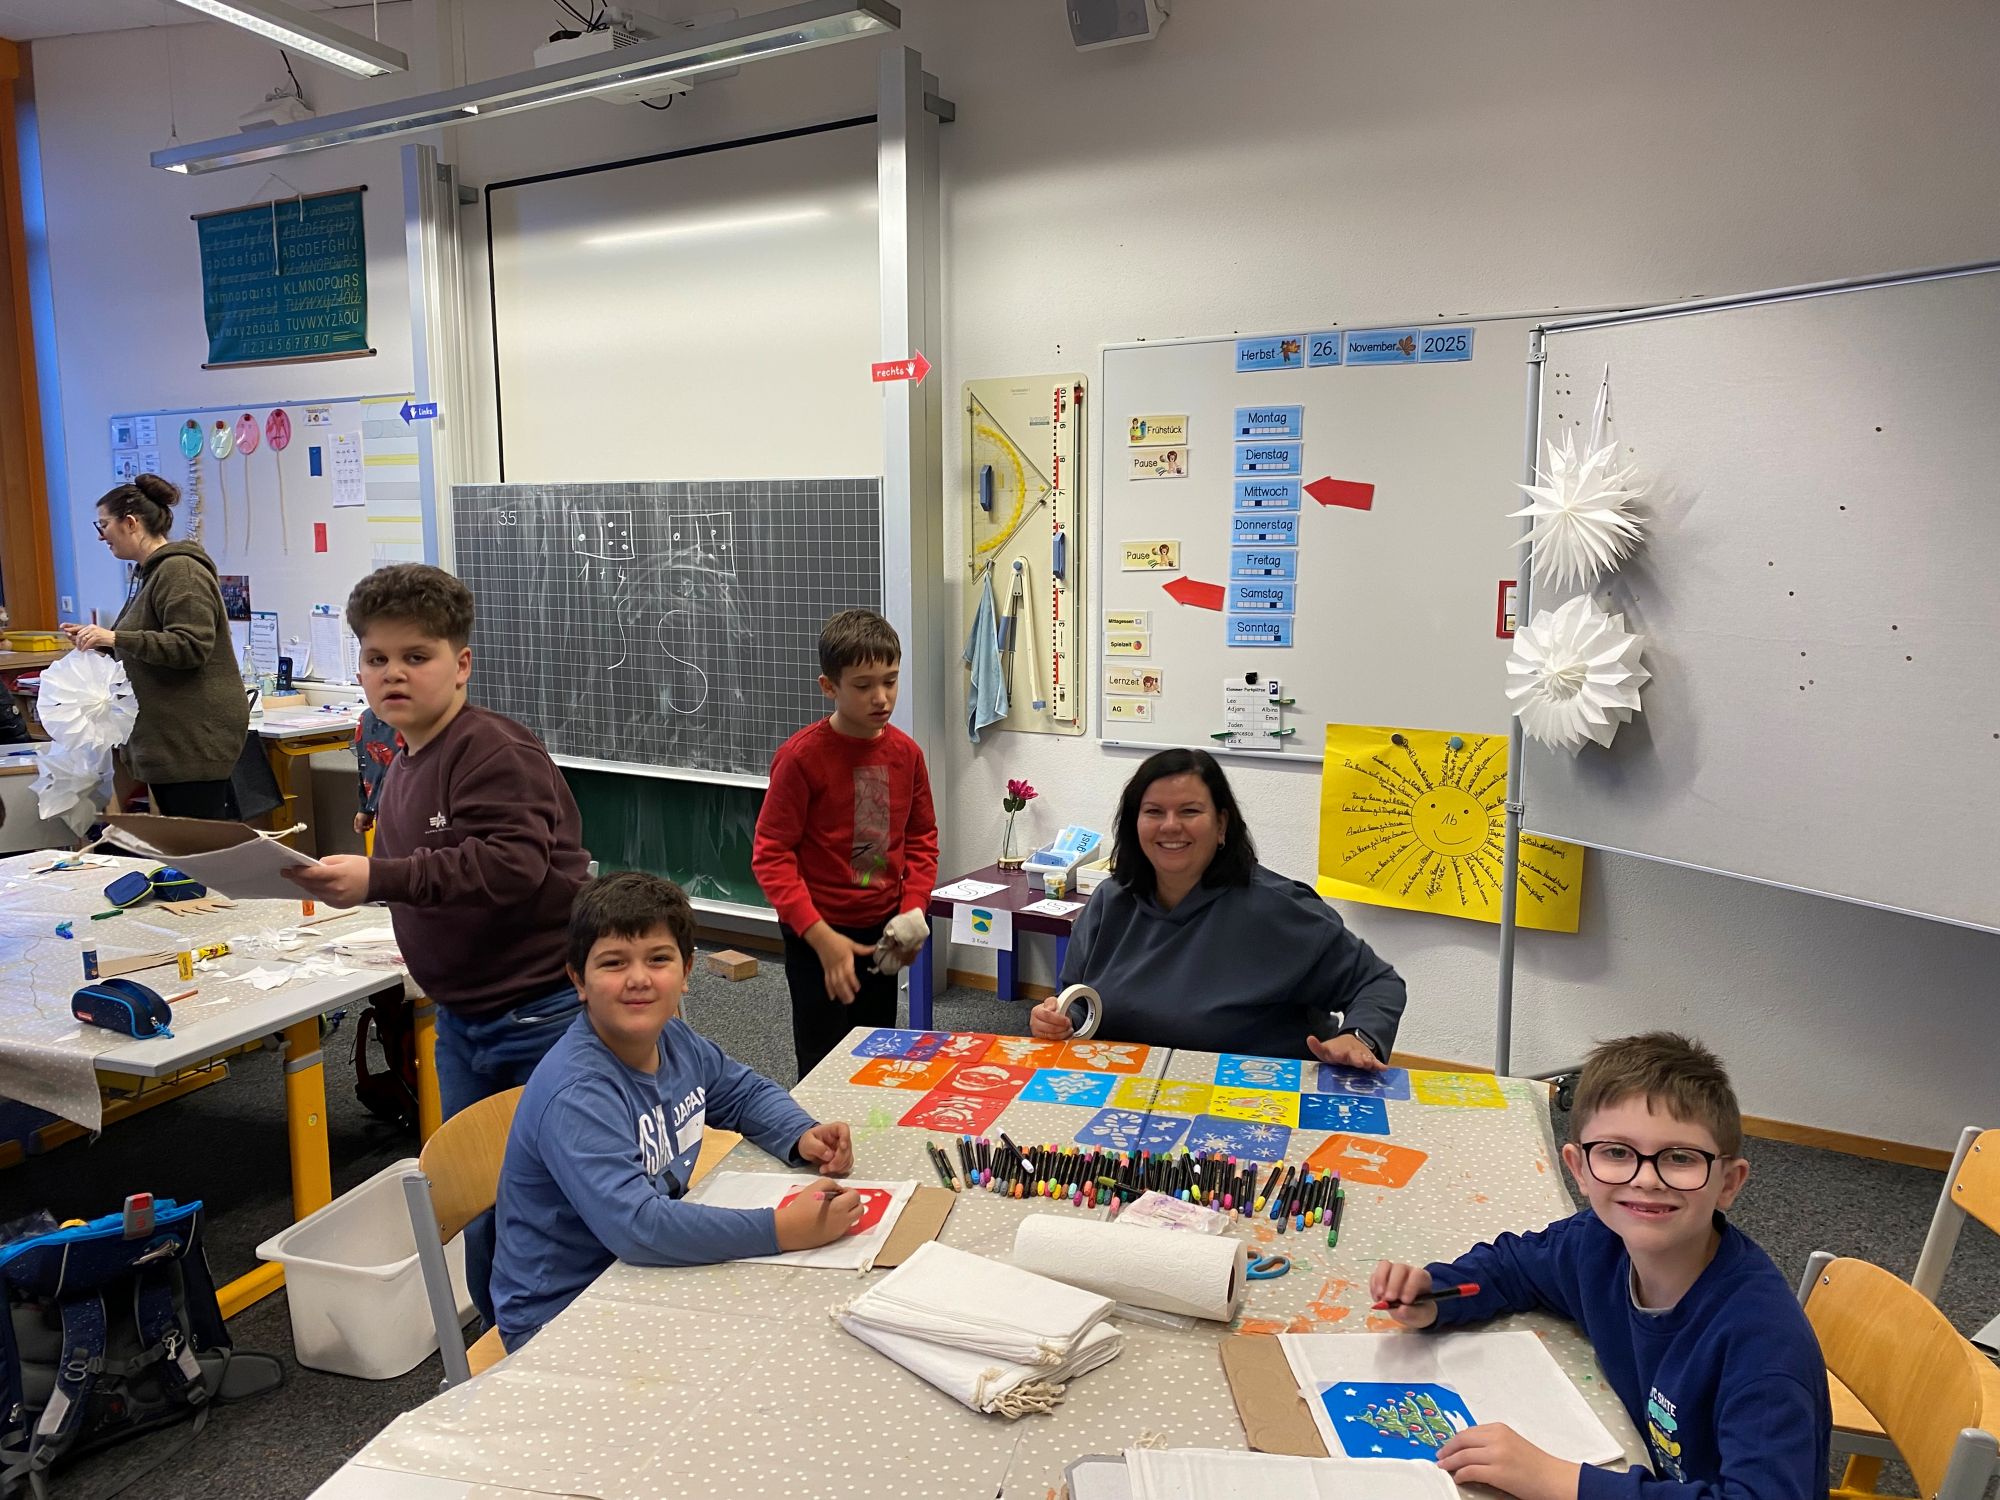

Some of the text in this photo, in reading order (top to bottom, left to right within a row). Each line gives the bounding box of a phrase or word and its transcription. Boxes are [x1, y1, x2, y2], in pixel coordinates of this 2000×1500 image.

[1313, 341, 1337, 357] 26.
[1424, 336, 1467, 352] 2025
[1241, 348, 1275, 360] Herbst
[877, 366, 904, 377] rechts
[1248, 412, 1287, 424] Montag
[1147, 425, 1182, 435] Frühstück
[1246, 449, 1289, 461] Dienstag
[1134, 458, 1158, 468] Pause
[1244, 486, 1288, 497] Mittwoch
[498, 510, 517, 525] 35
[1235, 520, 1293, 532] Donnerstag
[1126, 551, 1150, 560] Pause
[1246, 554, 1281, 567] Freitag
[1240, 588, 1284, 600] Samstag
[1237, 622, 1280, 634] Sonntag
[1109, 675, 1140, 685] Lernzeit
[1271, 683, 1277, 693] P
[1077, 833, 1092, 852] gust
